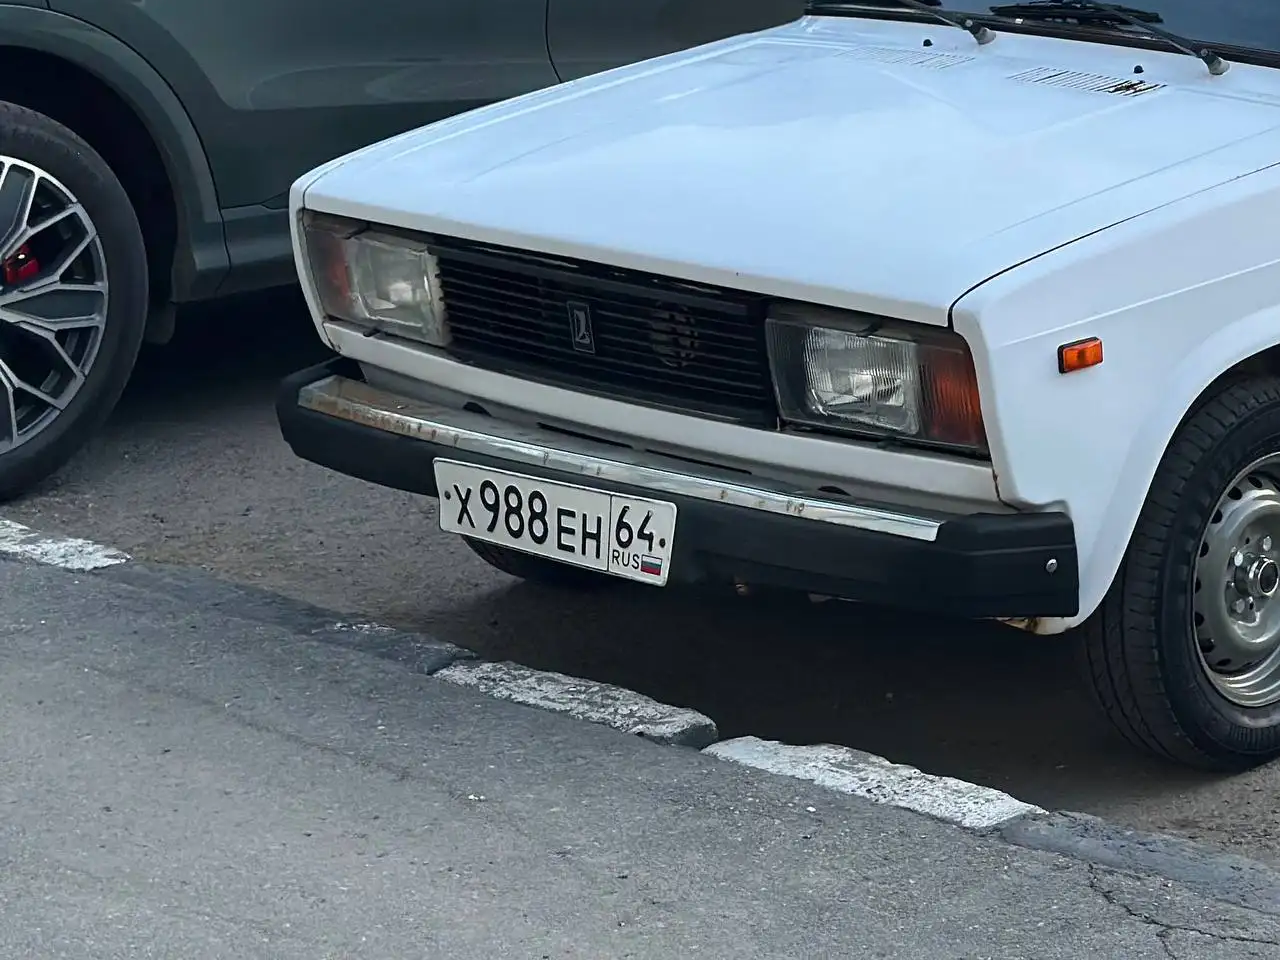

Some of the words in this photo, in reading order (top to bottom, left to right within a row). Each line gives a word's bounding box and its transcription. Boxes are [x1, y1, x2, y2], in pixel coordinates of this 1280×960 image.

[453, 479, 602, 559] Х988ЕН
[614, 505, 655, 552] 64
[611, 549, 640, 570] RUS
